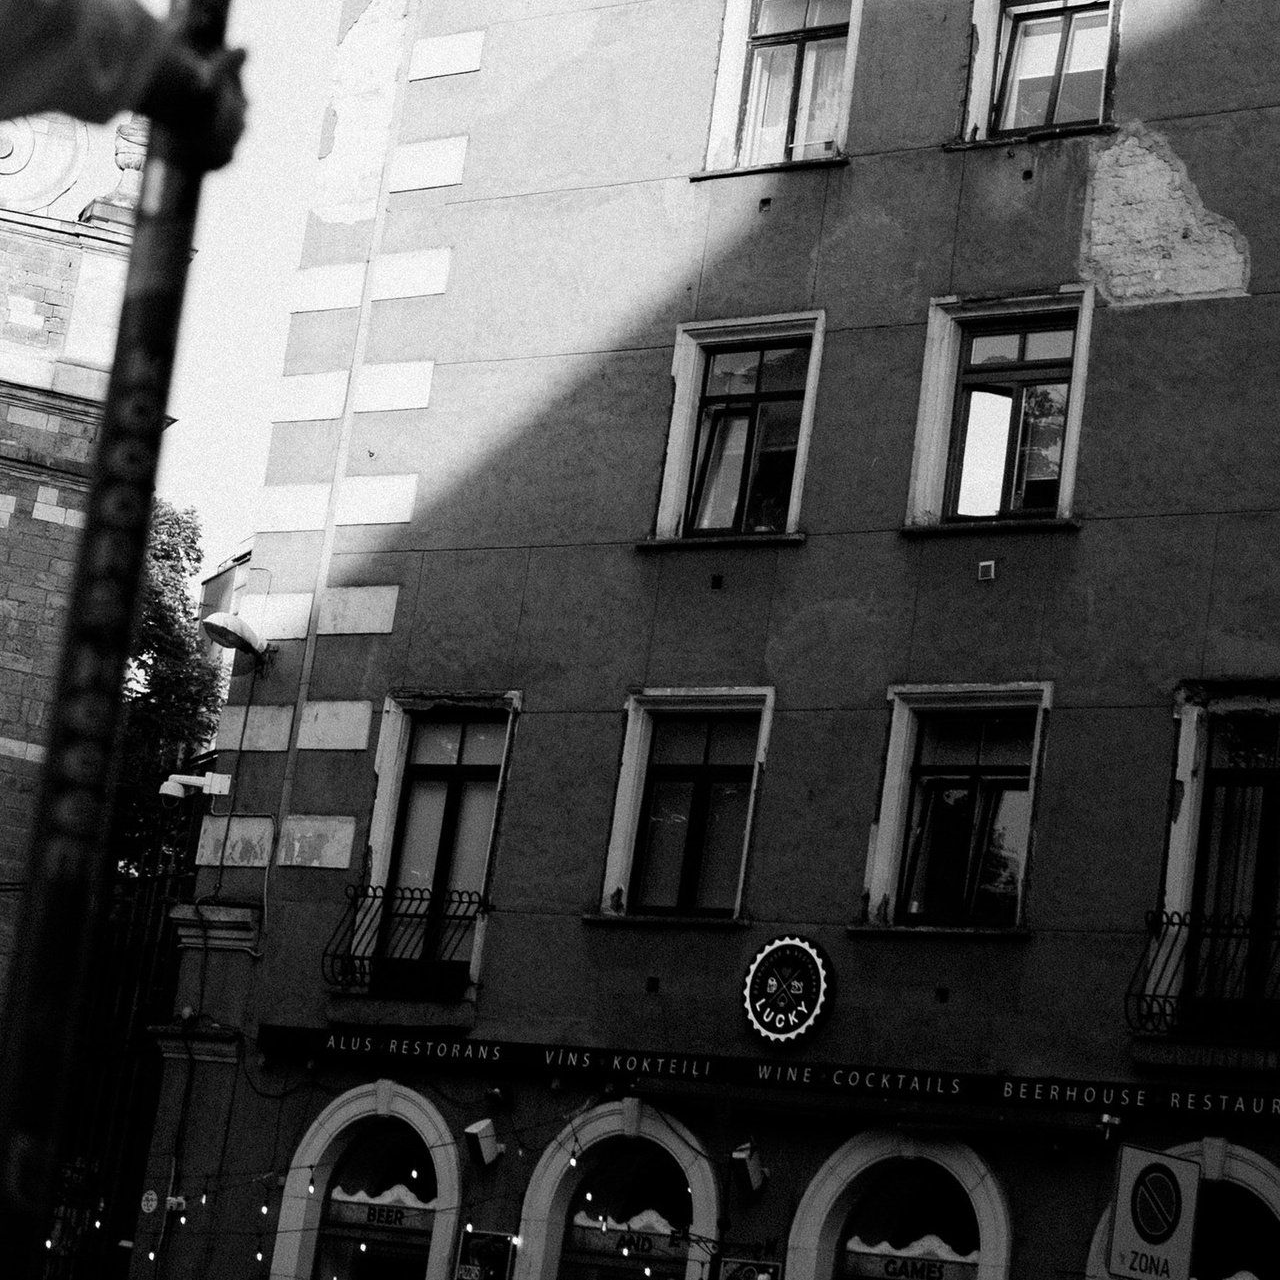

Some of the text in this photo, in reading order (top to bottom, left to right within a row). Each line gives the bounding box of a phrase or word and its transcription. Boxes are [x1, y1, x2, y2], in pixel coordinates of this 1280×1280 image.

[755, 998, 808, 1028] LUCKY
[326, 1035, 501, 1061] ALUS RESTORANS
[545, 1048, 711, 1078] VĪNS KOKTEIĻI
[758, 1065, 961, 1094] WINE COCKTAILS
[1003, 1081, 1280, 1115] BEERHOUSE RESTAUR
[367, 1206, 404, 1225] BEER
[884, 1259, 944, 1280] GAMES
[1129, 1250, 1170, 1278] ZONA
